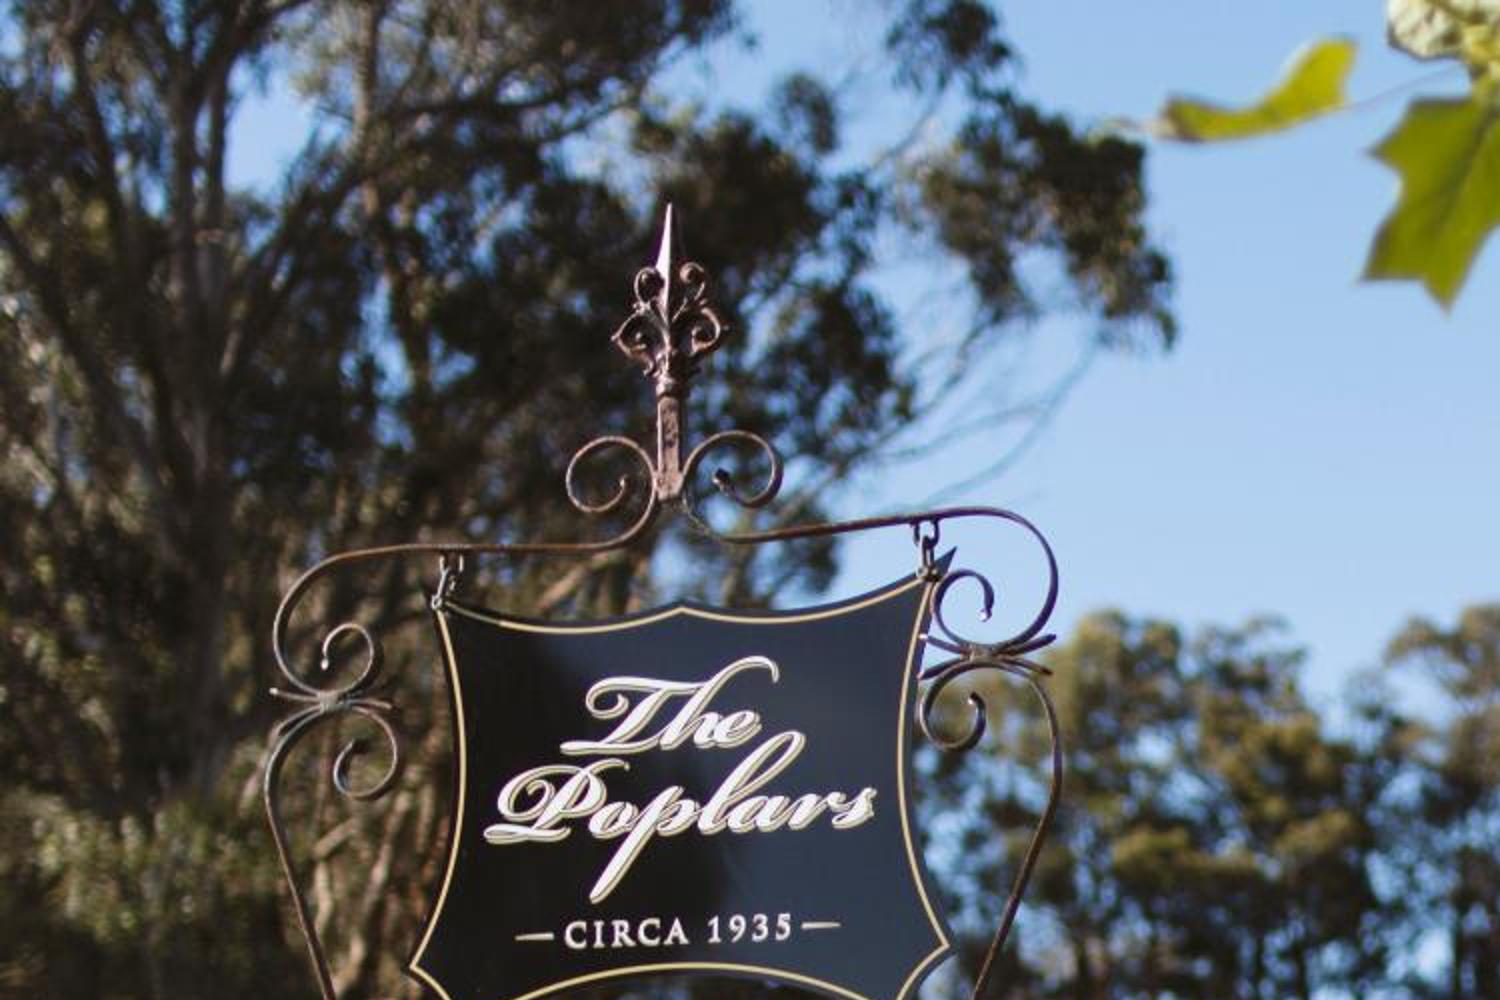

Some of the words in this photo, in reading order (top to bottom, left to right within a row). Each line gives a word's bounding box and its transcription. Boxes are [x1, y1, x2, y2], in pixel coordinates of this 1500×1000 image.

[559, 655, 781, 757] The
[483, 729, 878, 904] Poplars
[564, 917, 689, 949] CIRCA
[707, 912, 792, 944] 1935
